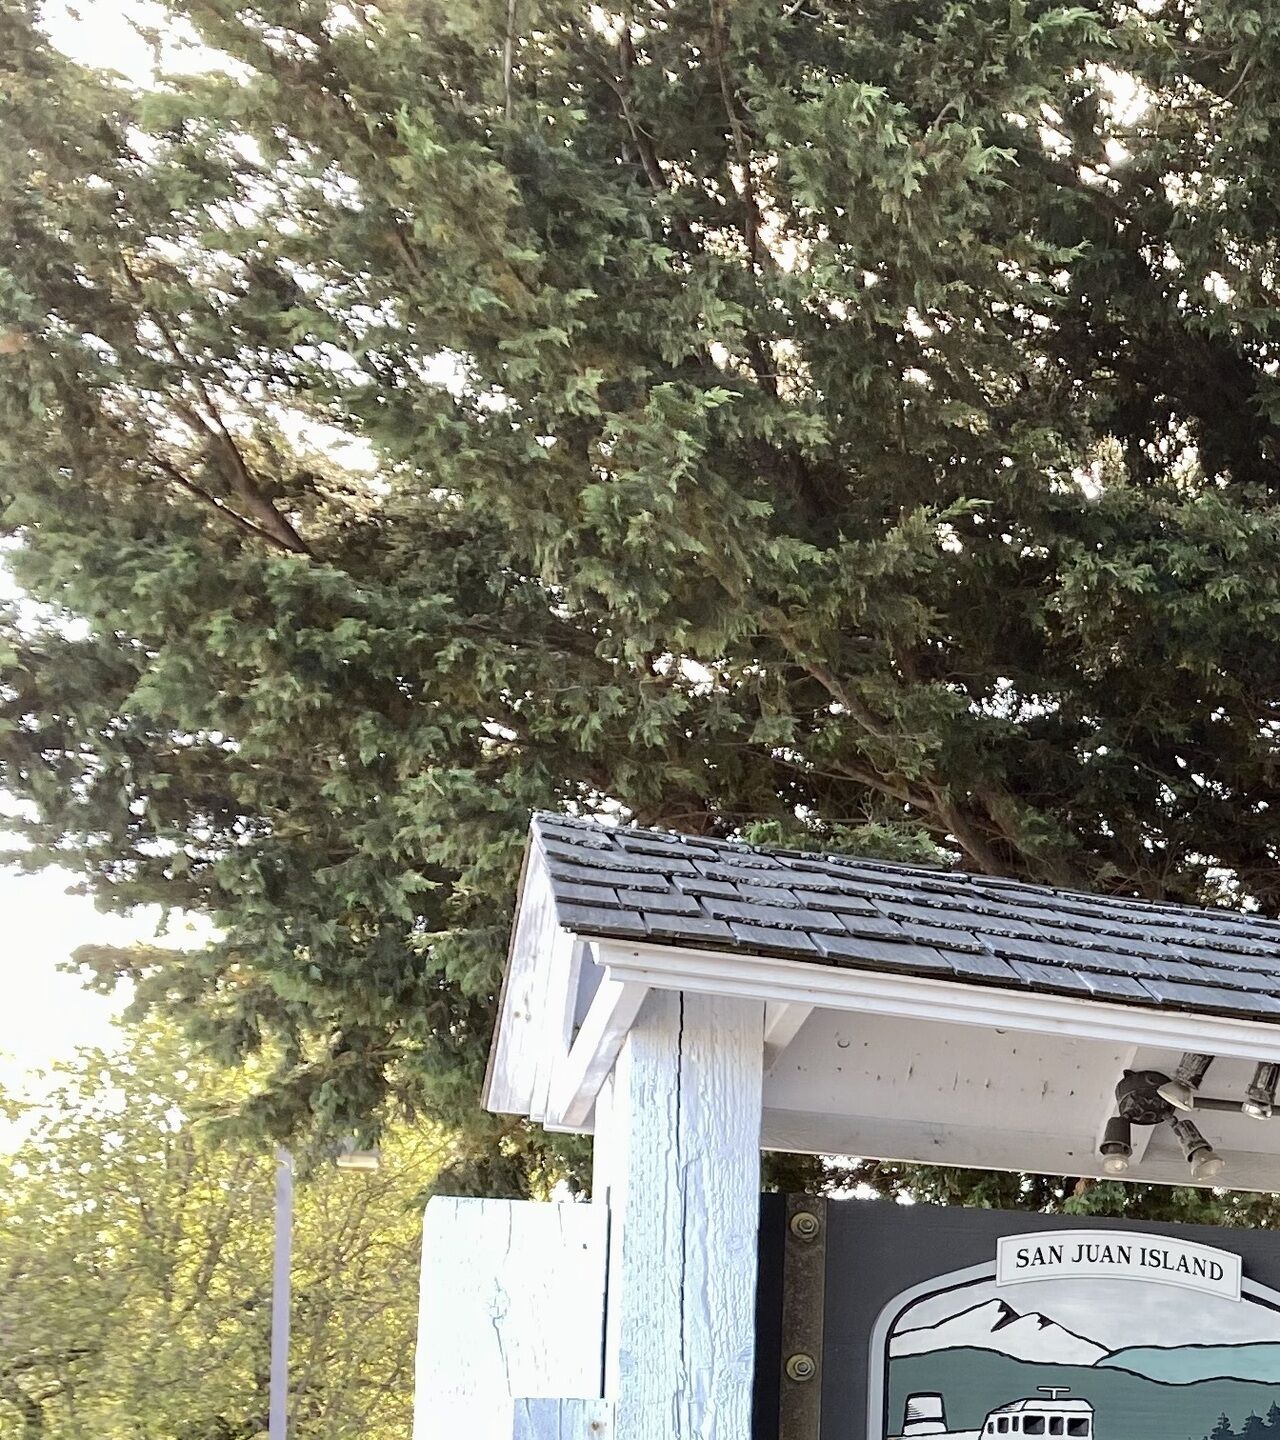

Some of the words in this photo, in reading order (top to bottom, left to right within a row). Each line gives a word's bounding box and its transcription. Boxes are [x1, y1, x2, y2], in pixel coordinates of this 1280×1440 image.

[1016, 1245, 1064, 1268] SAN
[1071, 1244, 1132, 1264] JUAN
[1140, 1247, 1224, 1281] ISLAND
